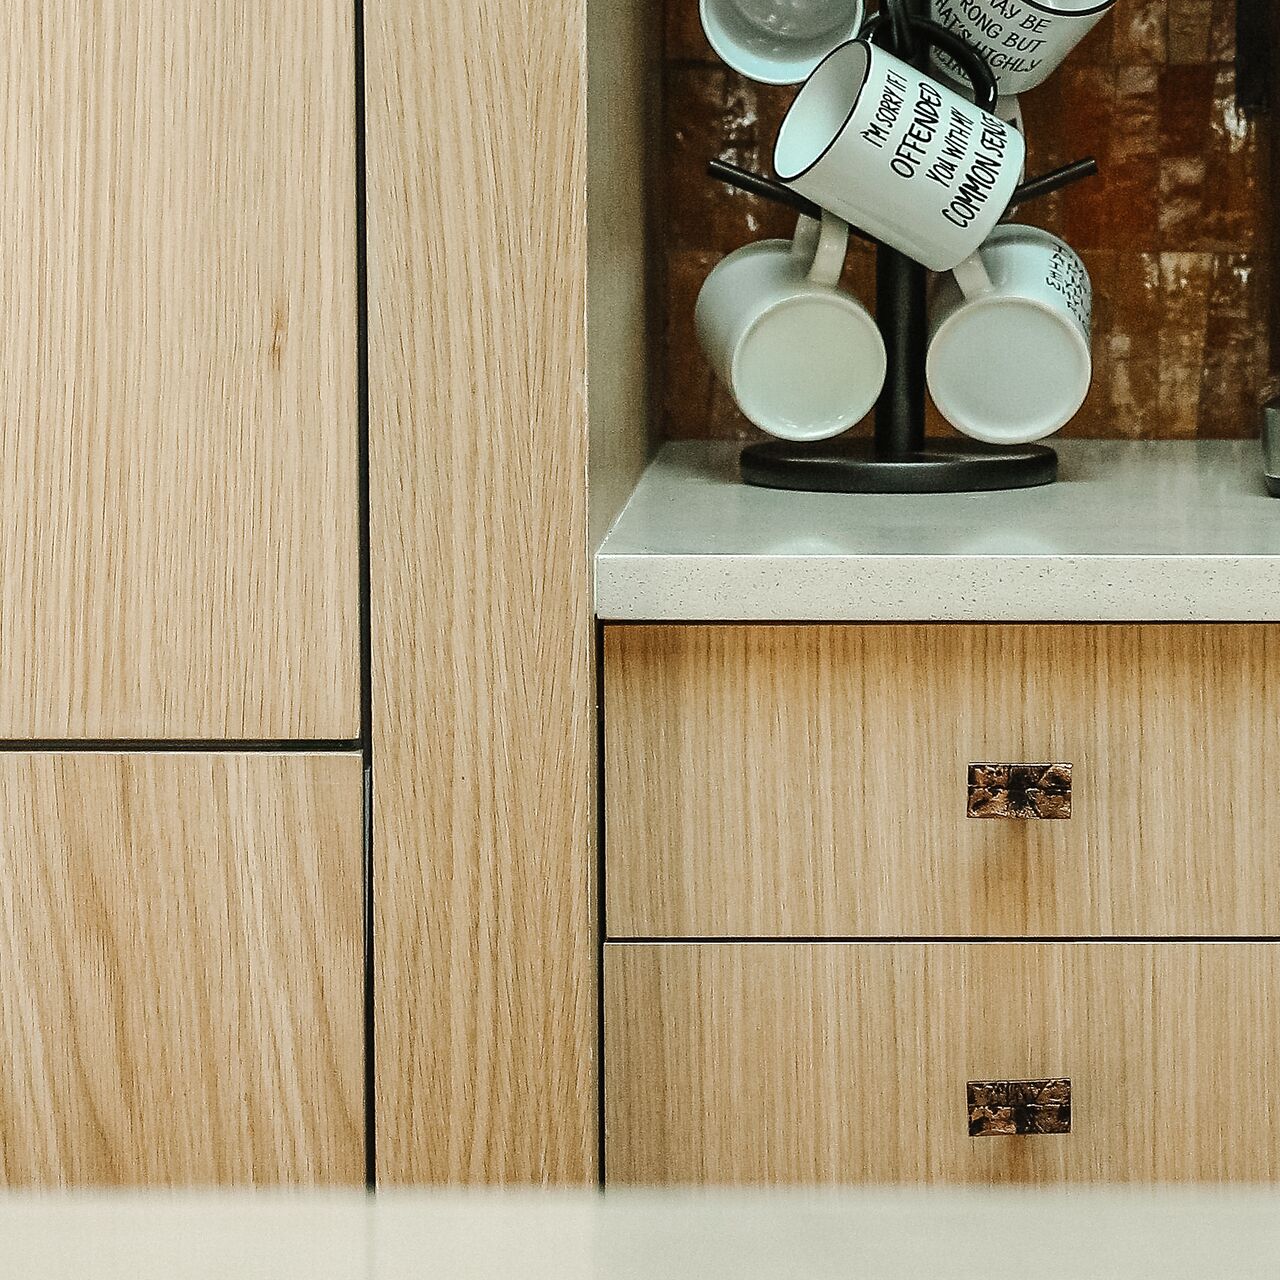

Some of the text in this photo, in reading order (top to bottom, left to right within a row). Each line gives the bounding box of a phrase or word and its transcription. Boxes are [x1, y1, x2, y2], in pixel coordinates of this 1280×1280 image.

[1019, 14, 1052, 33] BE
[1002, 32, 1046, 53] BUT
[860, 68, 908, 149] I'M SORRY IF I
[949, 106, 975, 128] MY
[890, 82, 943, 179] OFFENDED
[941, 122, 974, 160] WITH
[926, 156, 958, 188] YOU
[941, 151, 1002, 228] COMMON
